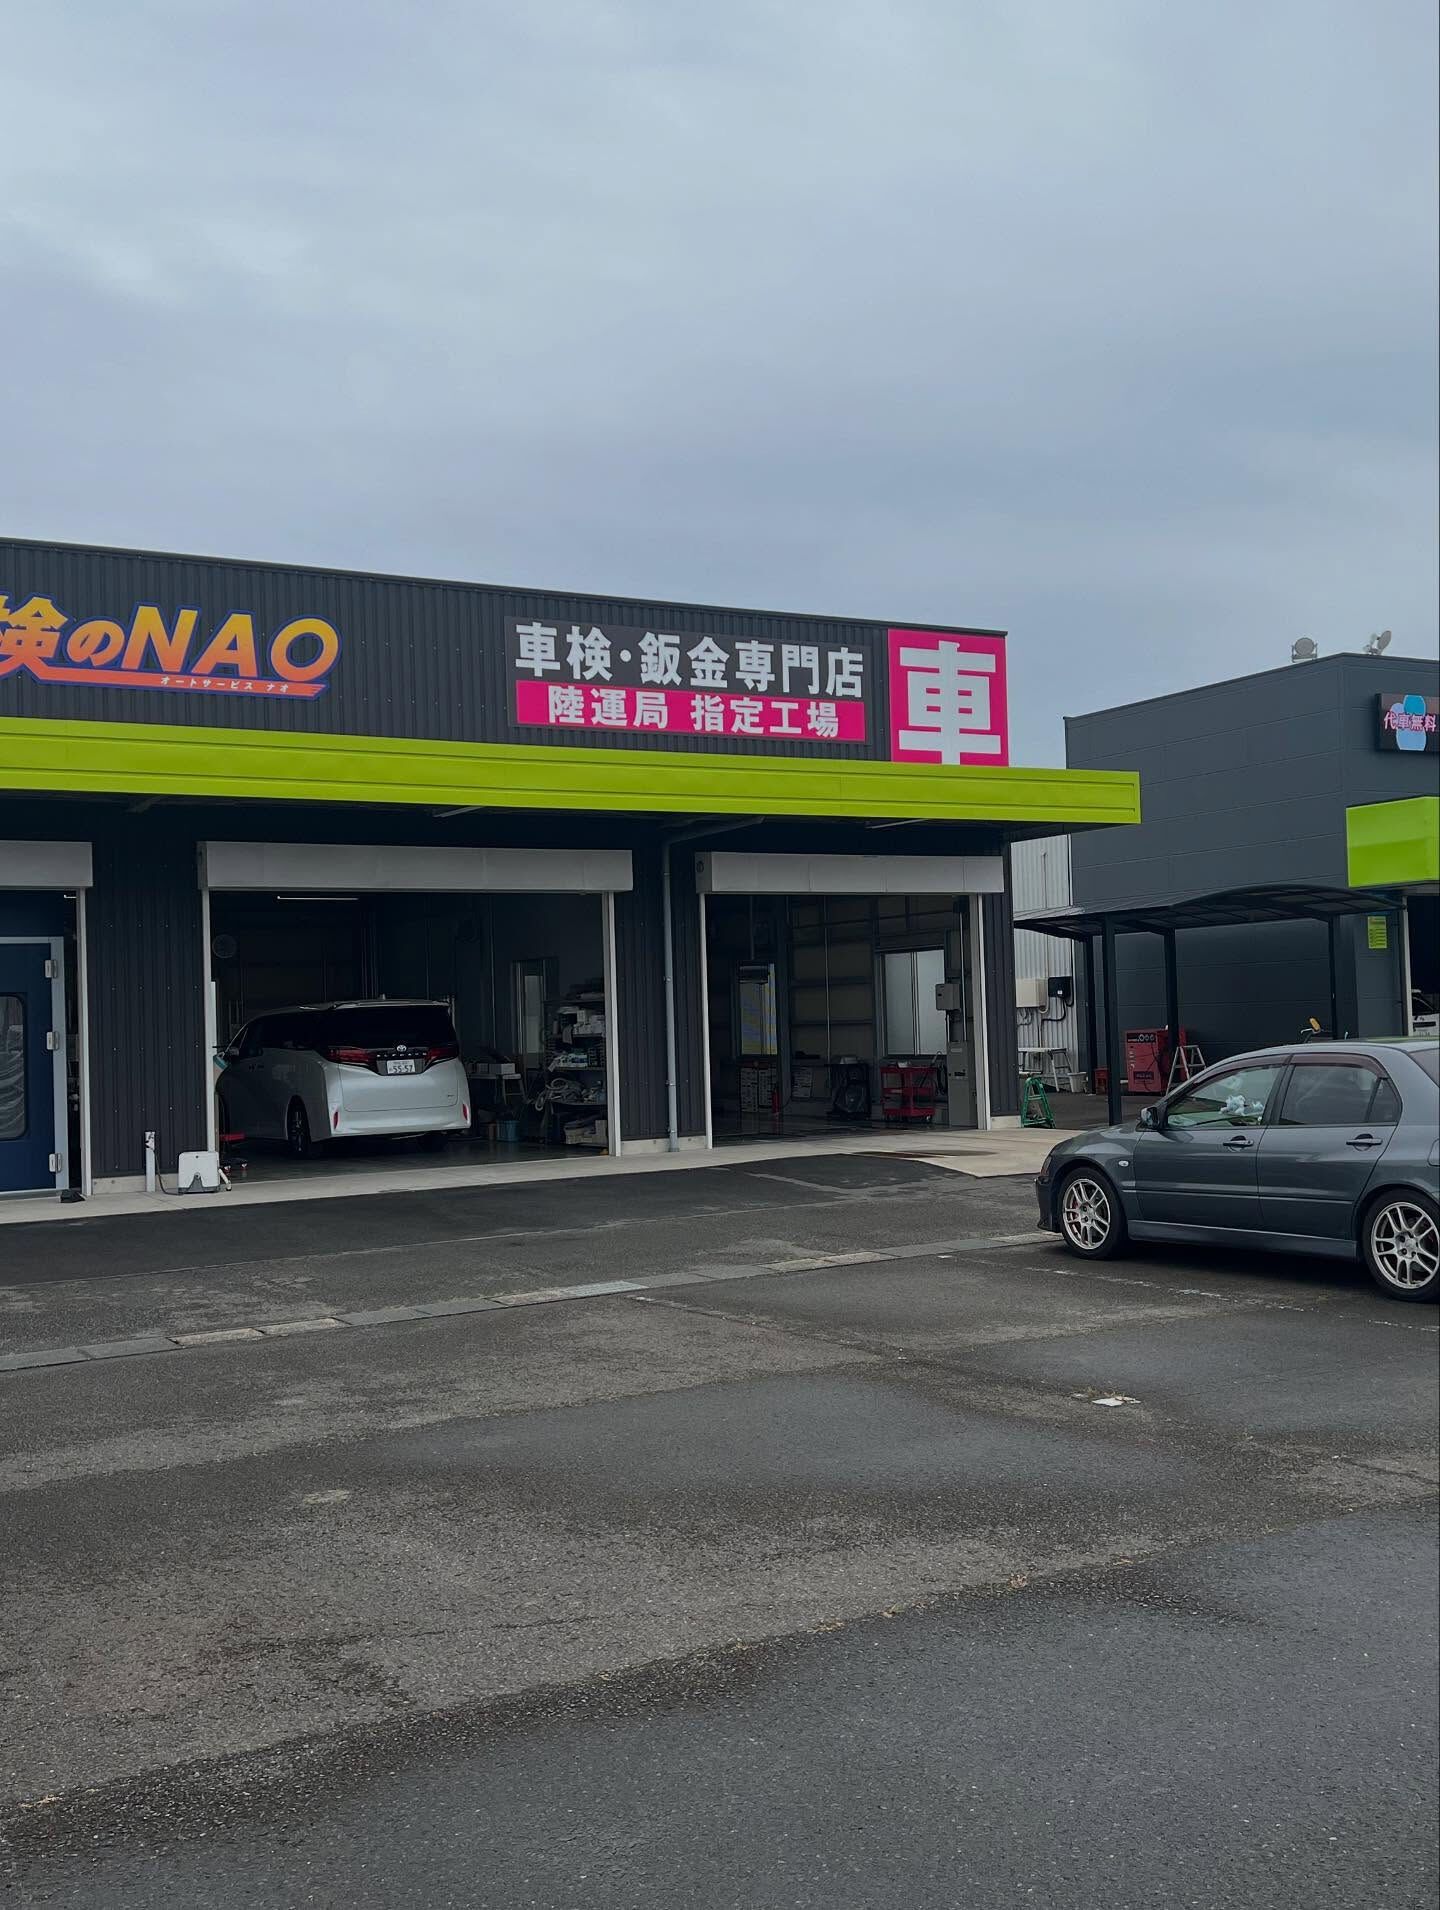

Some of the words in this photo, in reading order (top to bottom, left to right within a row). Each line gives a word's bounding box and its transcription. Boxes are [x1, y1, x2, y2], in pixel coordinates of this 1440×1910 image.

[160, 676, 253, 690] オートサービス
[266, 683, 289, 693] ナオ
[515, 622, 864, 698] 車検・鈑金専門店
[547, 685, 669, 729] 陸運局
[690, 694, 839, 739] 指定工場
[899, 641, 1001, 765] 車
[1384, 711, 1436, 732] 代車無料
